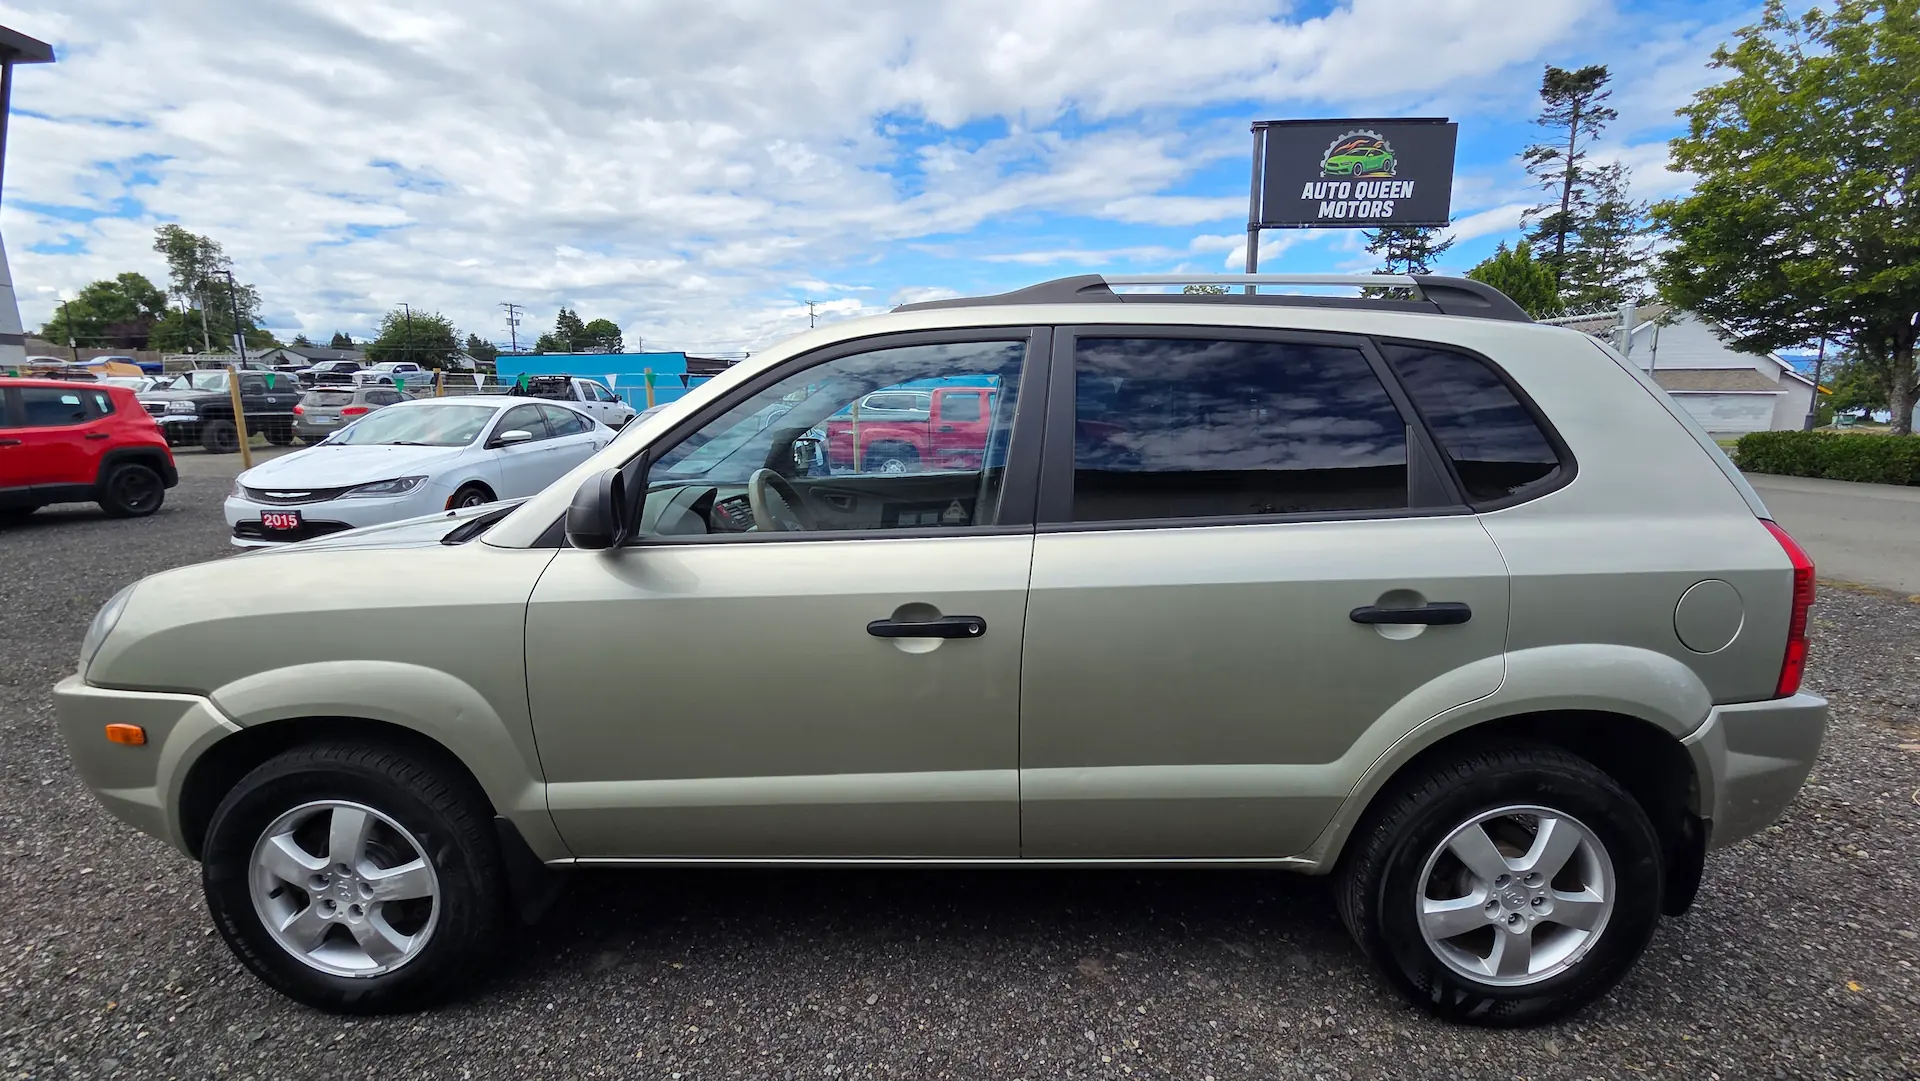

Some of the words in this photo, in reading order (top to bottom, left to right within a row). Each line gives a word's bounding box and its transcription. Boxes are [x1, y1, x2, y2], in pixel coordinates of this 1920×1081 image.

[1301, 181, 1351, 200] AUTO
[1354, 180, 1415, 201] QUEEN
[1318, 200, 1394, 219] MOTORS
[263, 514, 298, 526] 2015
